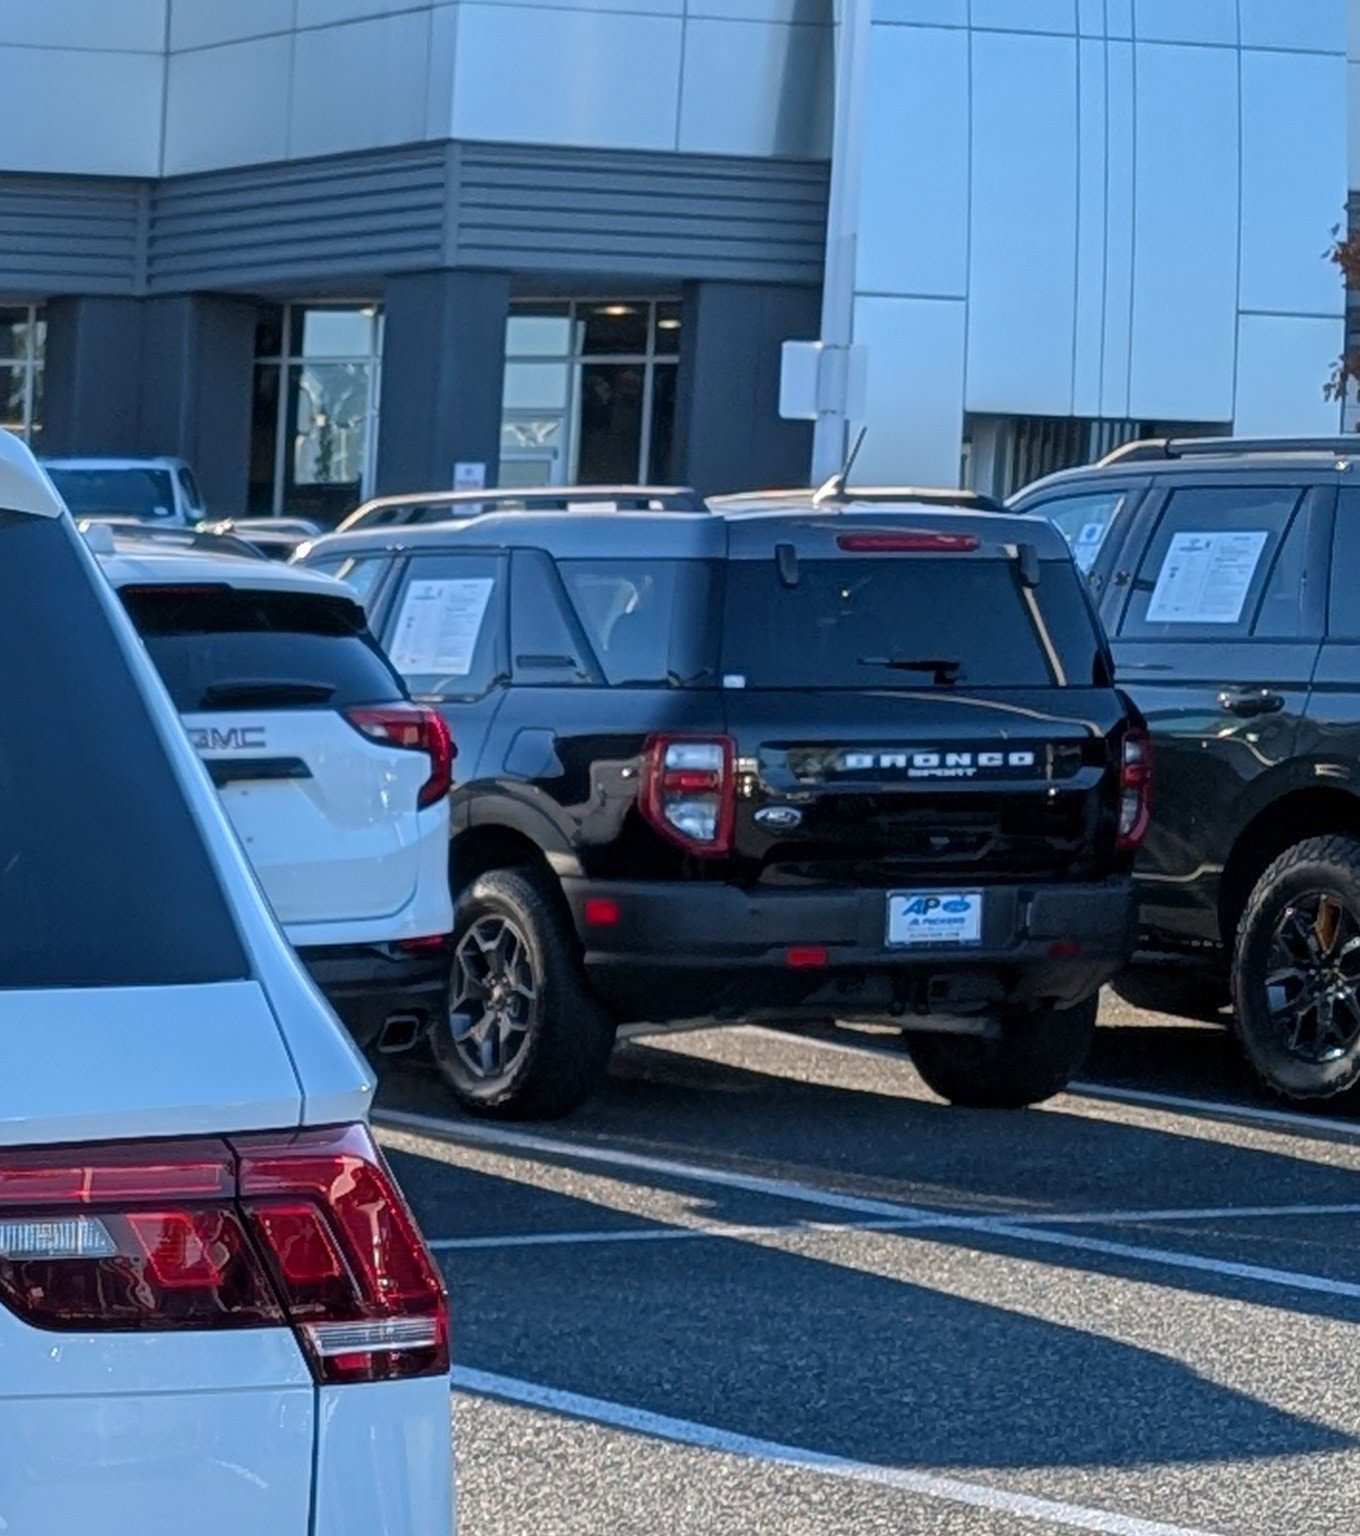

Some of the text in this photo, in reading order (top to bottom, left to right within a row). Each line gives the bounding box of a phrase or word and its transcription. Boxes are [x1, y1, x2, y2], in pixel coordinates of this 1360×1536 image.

[185, 727, 267, 750] GMC
[845, 752, 1035, 769] BRONCO
[902, 897, 941, 916] AP
